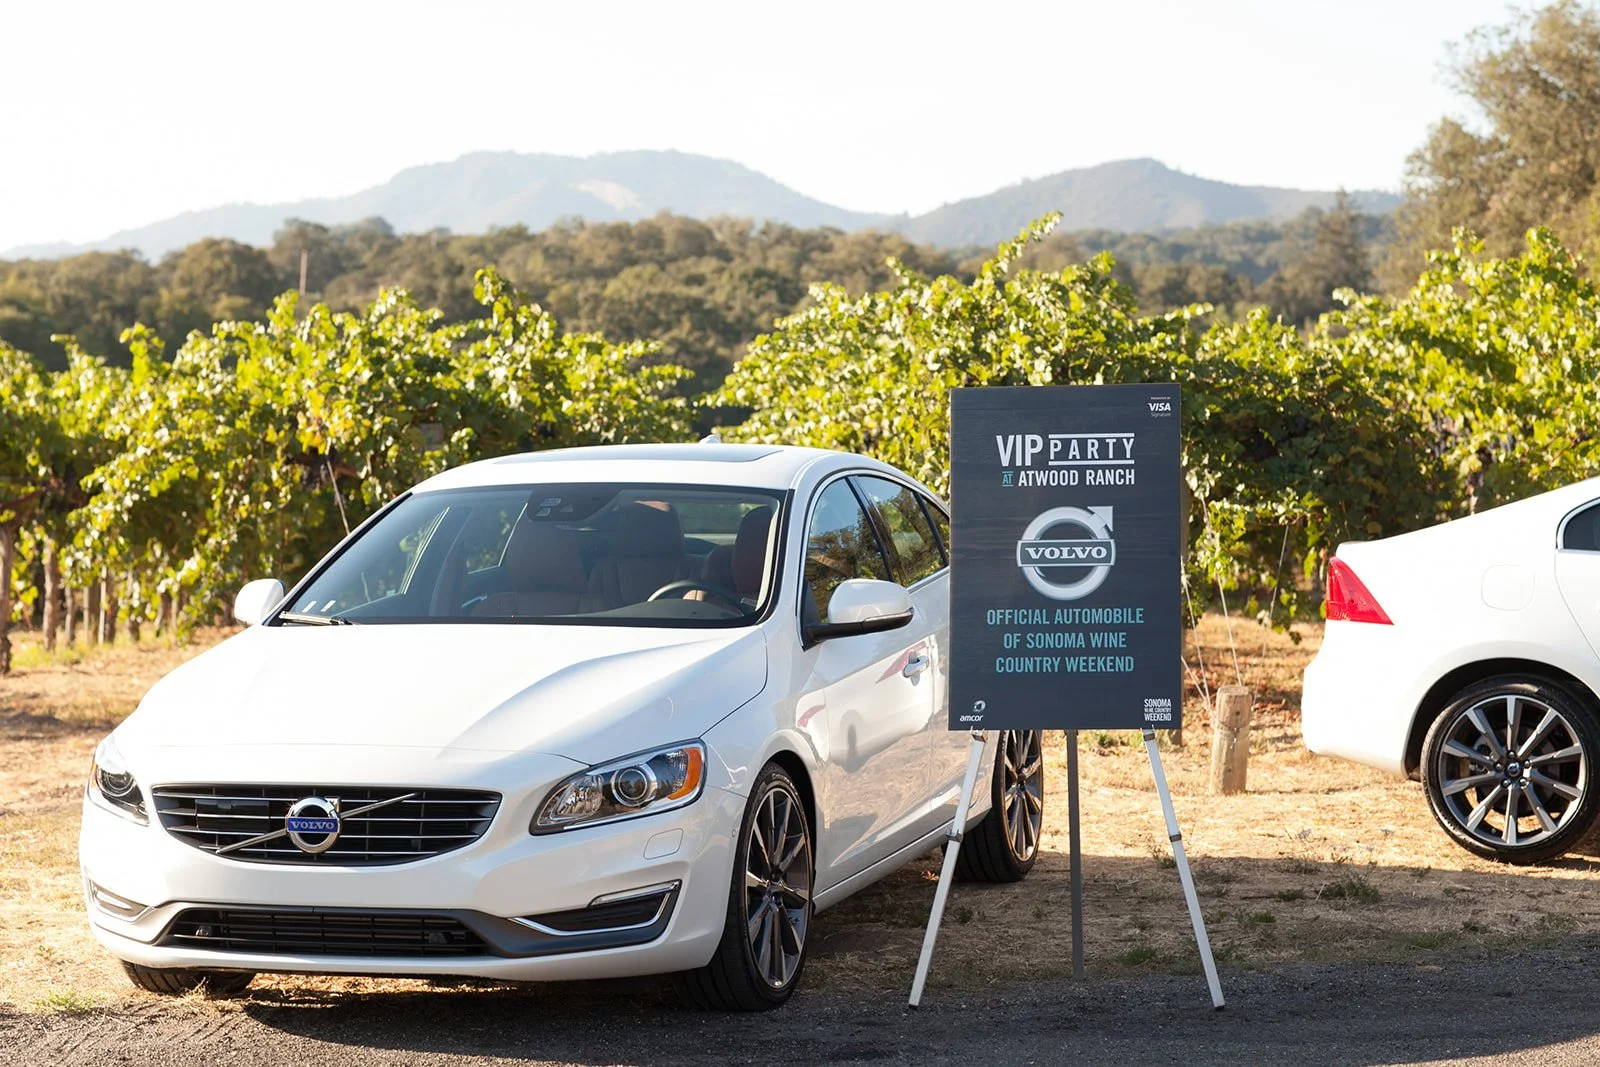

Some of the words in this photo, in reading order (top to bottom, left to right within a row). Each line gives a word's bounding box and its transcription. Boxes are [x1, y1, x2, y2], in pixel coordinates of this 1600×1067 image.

[1147, 402, 1171, 411] VISA
[996, 434, 1043, 467] VIP
[1049, 438, 1135, 460] PARTY
[1002, 473, 1013, 485] AT
[1018, 469, 1079, 487] ATWOOD
[1086, 469, 1135, 485] RANCH
[1025, 547, 1107, 560] VOLVO
[986, 609, 1050, 625] OFFICIAL
[1054, 608, 1144, 625] AUTOMOBILE
[1003, 633, 1021, 649] OF
[1026, 632, 1085, 649] SONOMA
[1090, 632, 1127, 648] WINE
[995, 656, 1061, 673] COUNTRY
[1065, 656, 1134, 672] WEEKEND
[1144, 698, 1172, 707] SONOMA
[1144, 713, 1172, 721] WEEKEND
[291, 821, 335, 830] VOLVO
